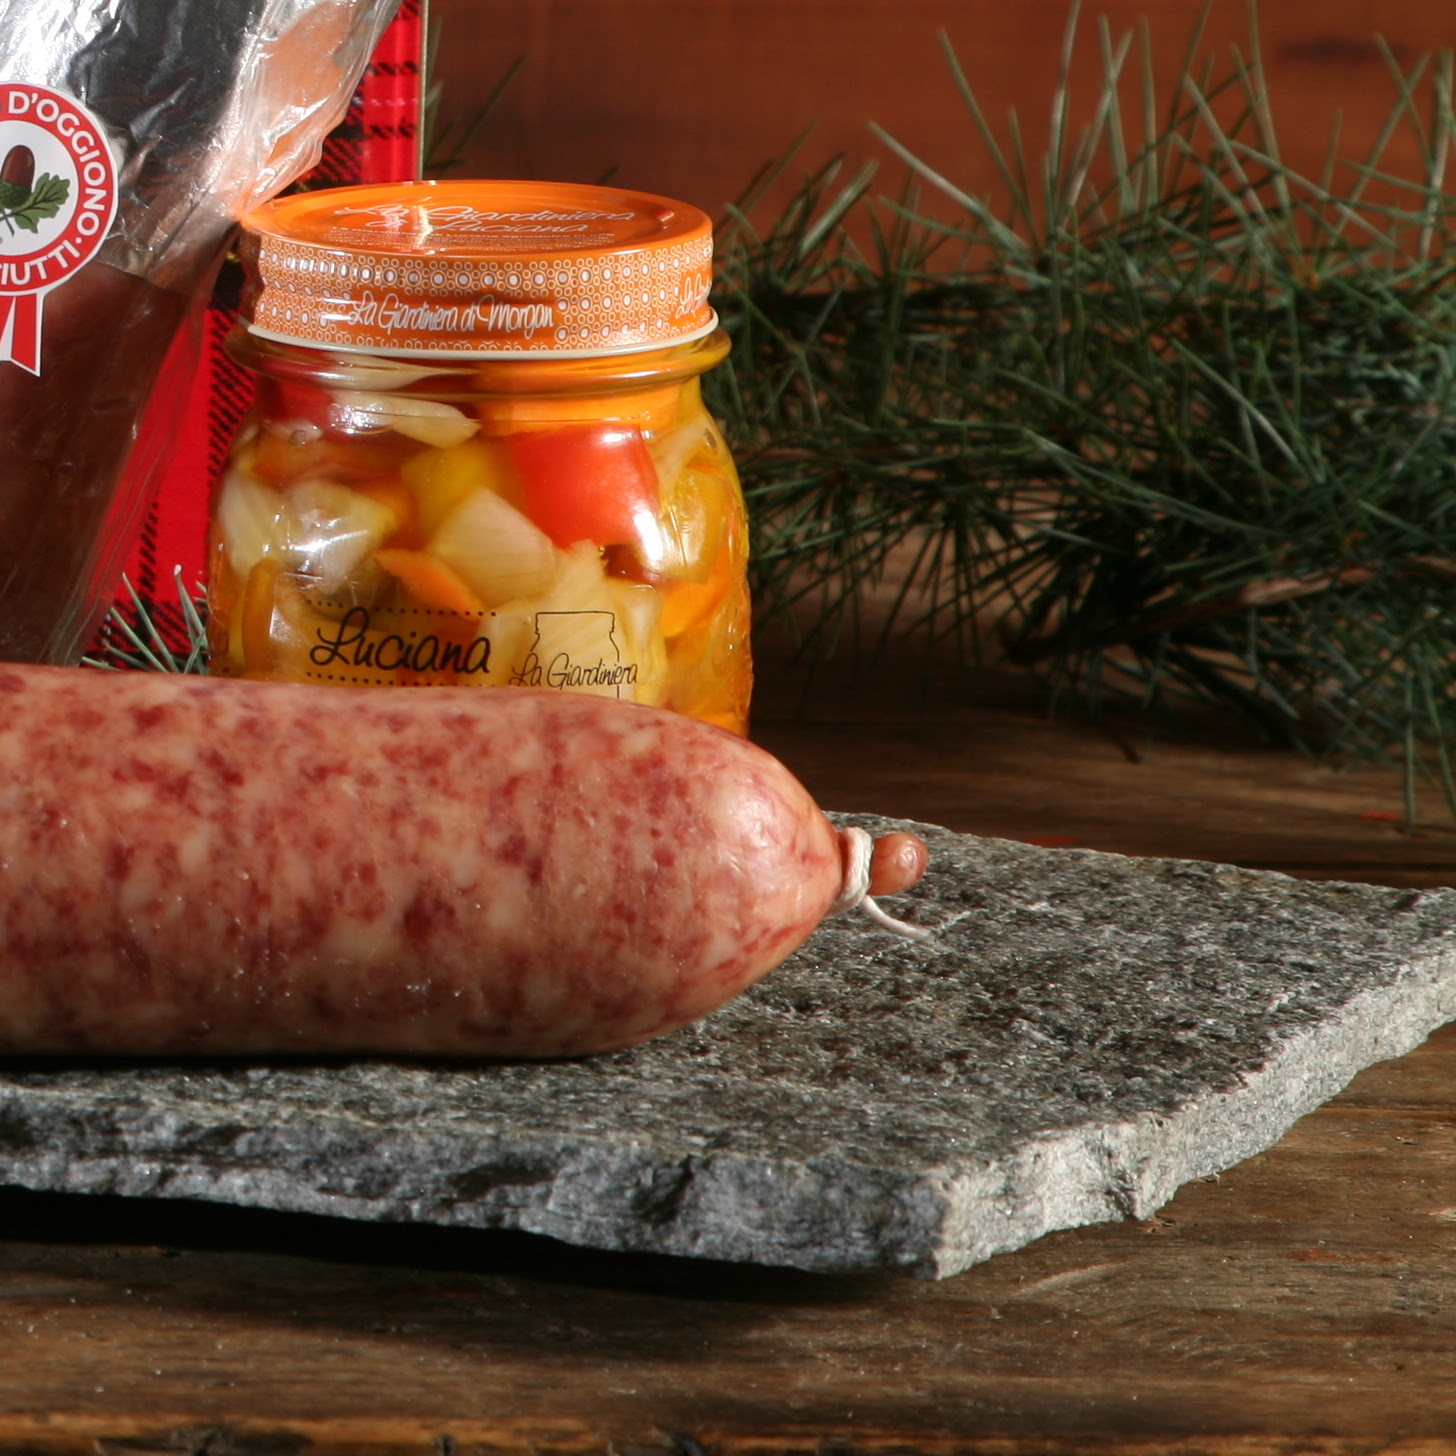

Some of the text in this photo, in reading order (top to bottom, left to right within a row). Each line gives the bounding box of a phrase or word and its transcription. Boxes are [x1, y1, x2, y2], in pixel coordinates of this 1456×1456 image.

[8, 90, 107, 237] D'OGGIONO
[348, 290, 375, 326] La
[379, 293, 457, 335] Giardiniera
[476, 294, 555, 338] Morgan
[309, 605, 492, 675] Luciana
[508, 652, 638, 691] La Giardiniera
